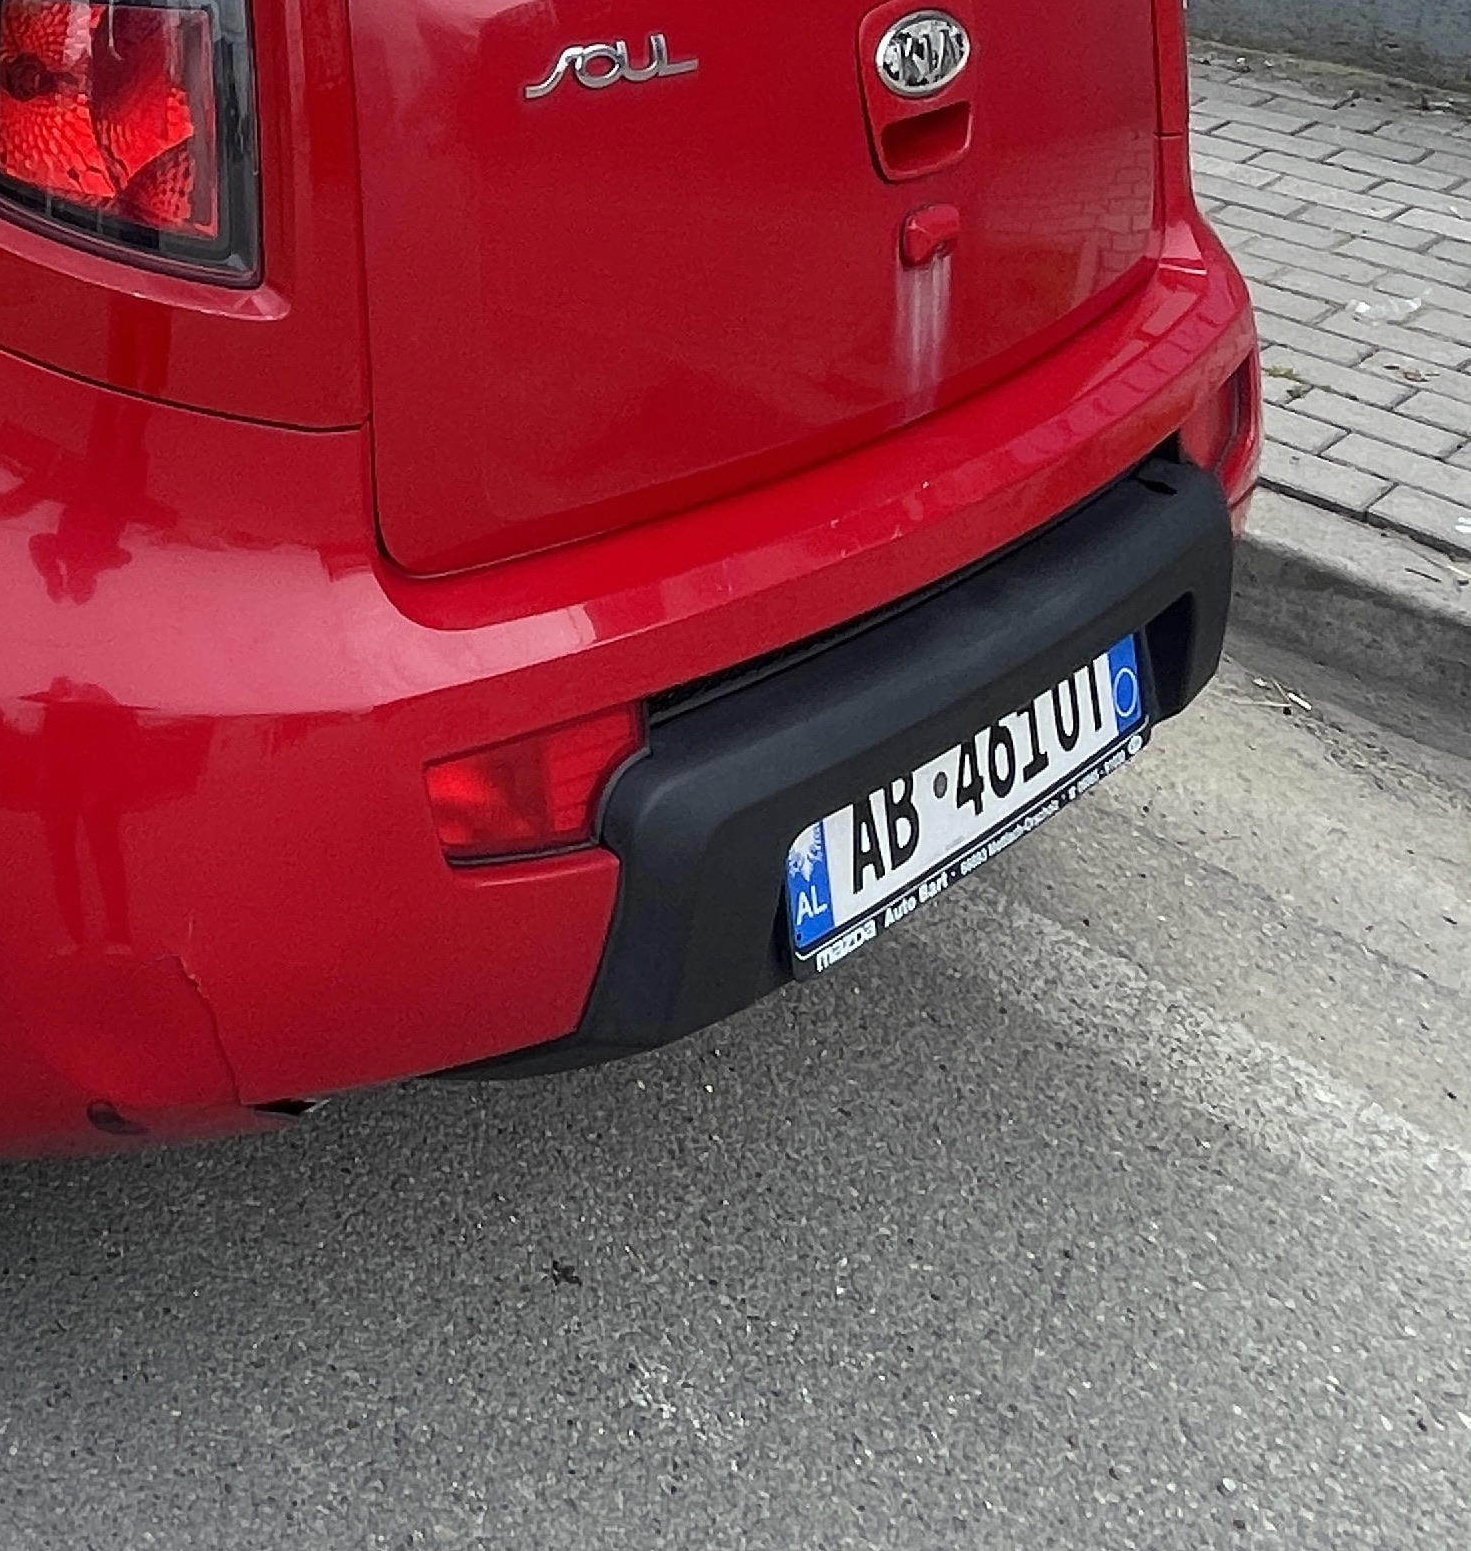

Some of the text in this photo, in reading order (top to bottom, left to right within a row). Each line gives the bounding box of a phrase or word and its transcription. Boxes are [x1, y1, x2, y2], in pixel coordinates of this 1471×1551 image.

[525, 33, 699, 99] SOUL
[852, 772, 920, 894] AB
[797, 885, 828, 926] AL
[884, 896, 917, 928] Auto
